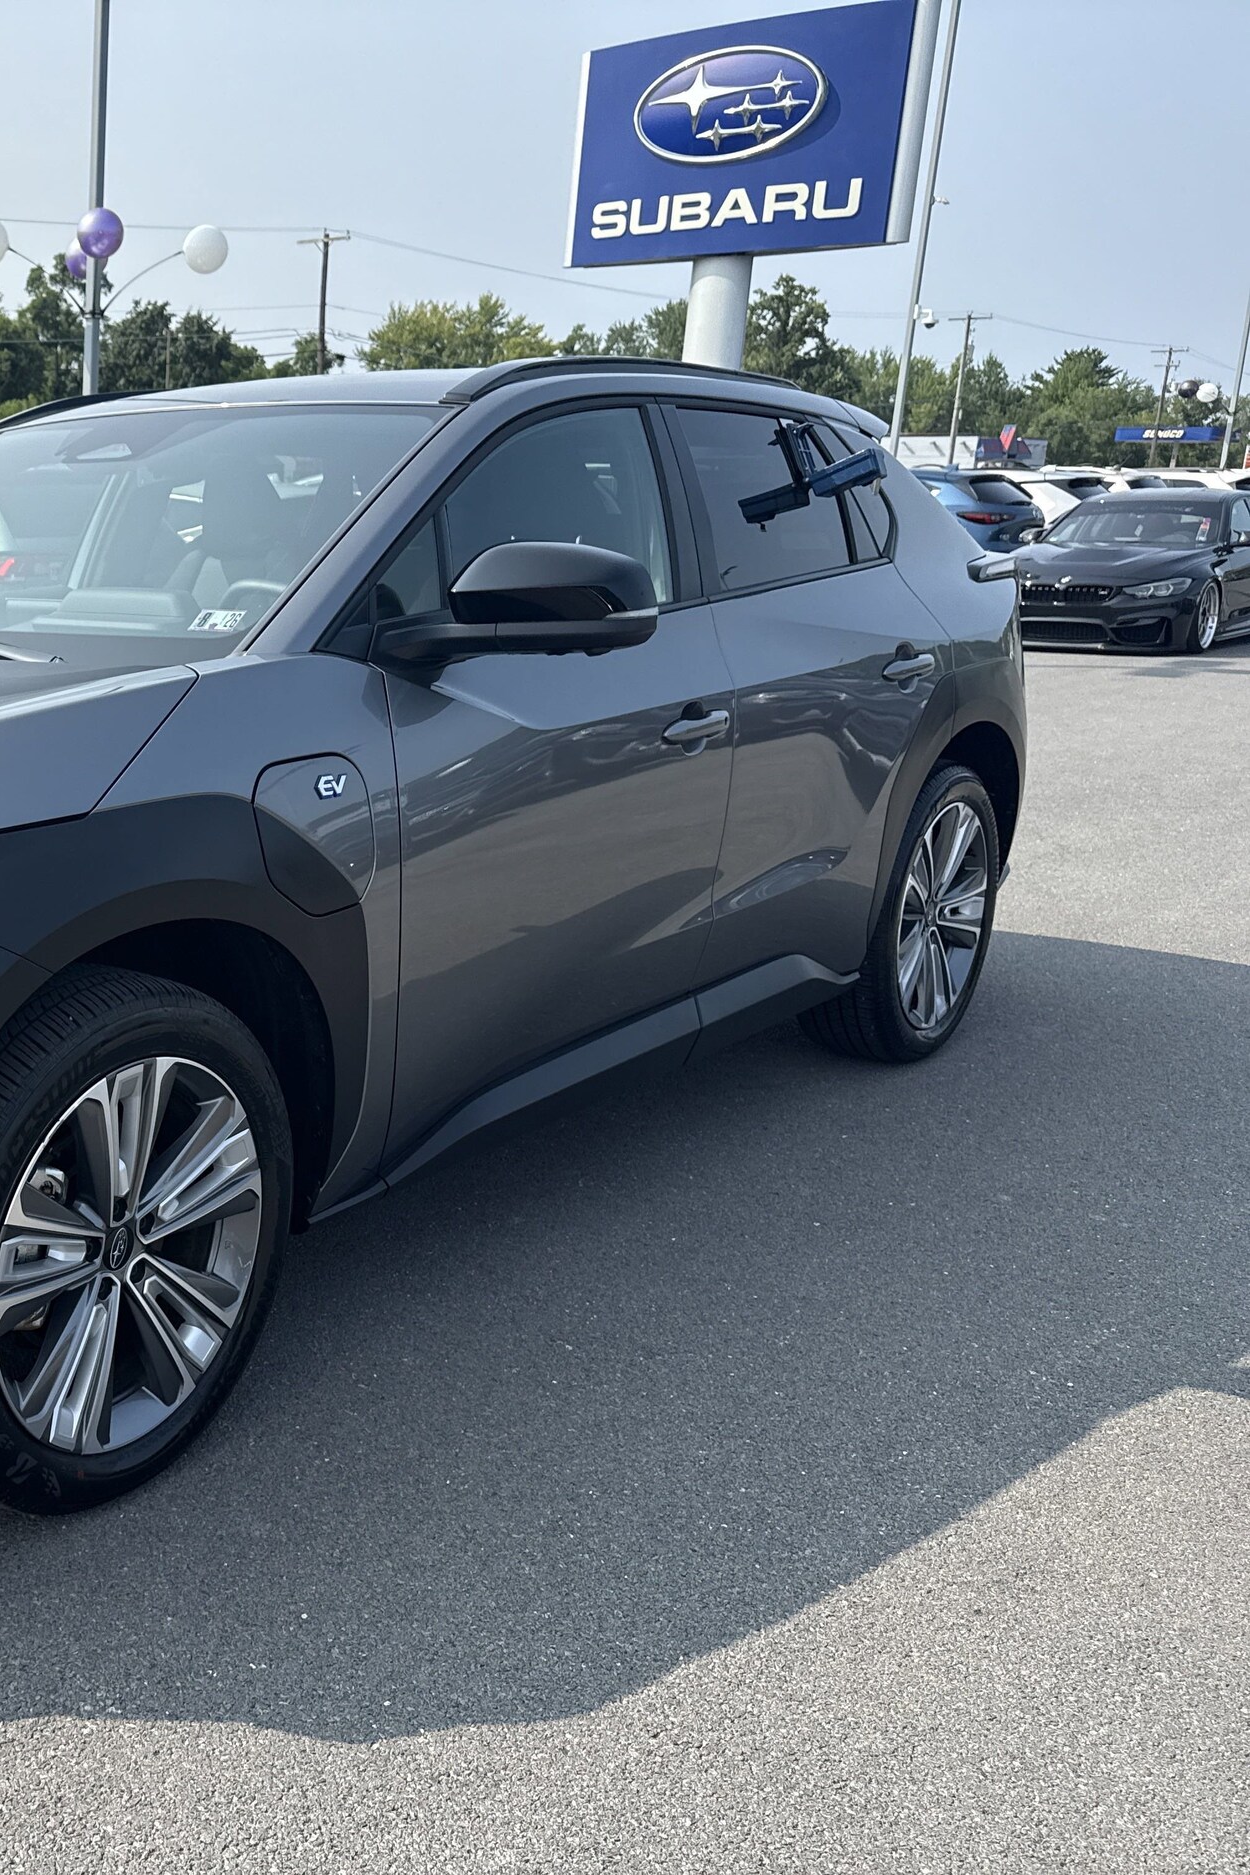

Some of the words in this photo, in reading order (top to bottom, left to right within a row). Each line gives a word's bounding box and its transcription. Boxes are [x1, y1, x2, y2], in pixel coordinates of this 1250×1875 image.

[590, 177, 863, 240] SUBARU
[197, 612, 213, 628] 8
[223, 613, 242, 628] 26
[316, 774, 347, 798] EV
